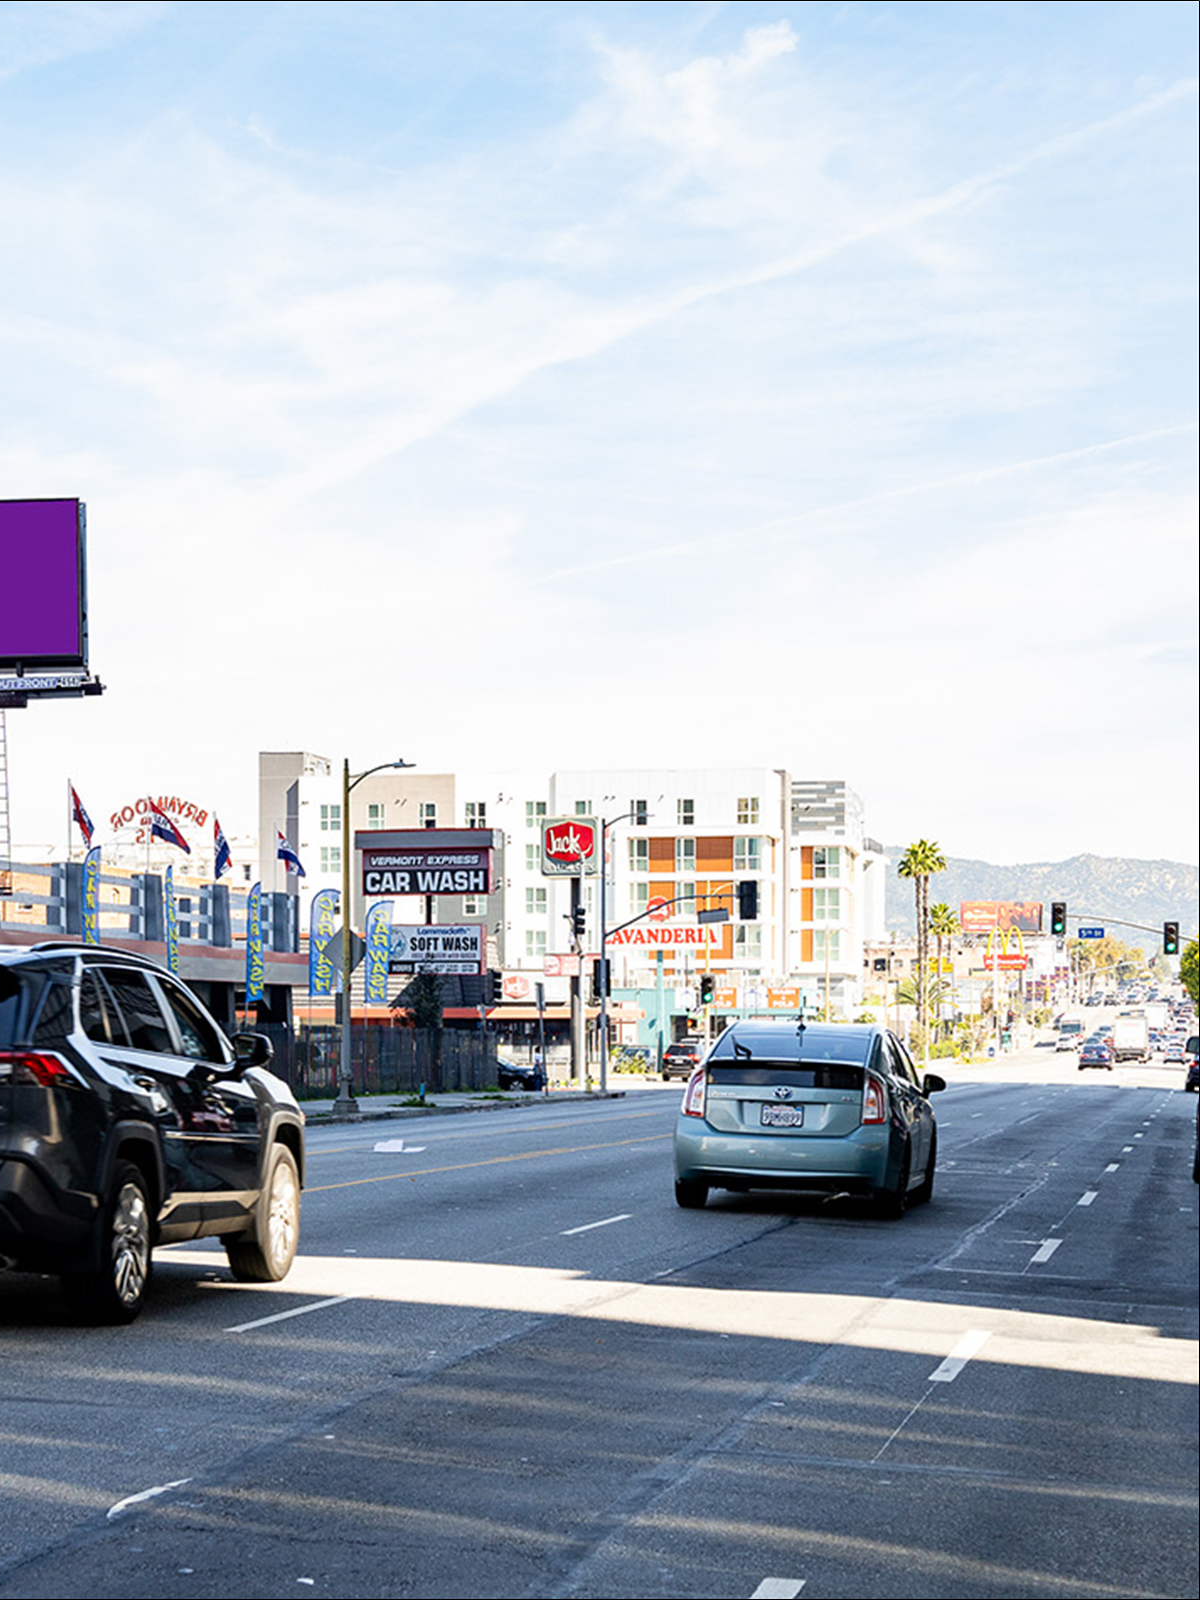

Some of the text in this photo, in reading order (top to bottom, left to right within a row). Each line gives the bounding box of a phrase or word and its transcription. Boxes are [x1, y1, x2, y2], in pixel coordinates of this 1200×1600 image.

[547, 826, 592, 855] Jack
[371, 855, 479, 866] VERMONT EXPRESS
[365, 871, 484, 892] CAR WASH
[410, 937, 478, 951] SOFT WASH
